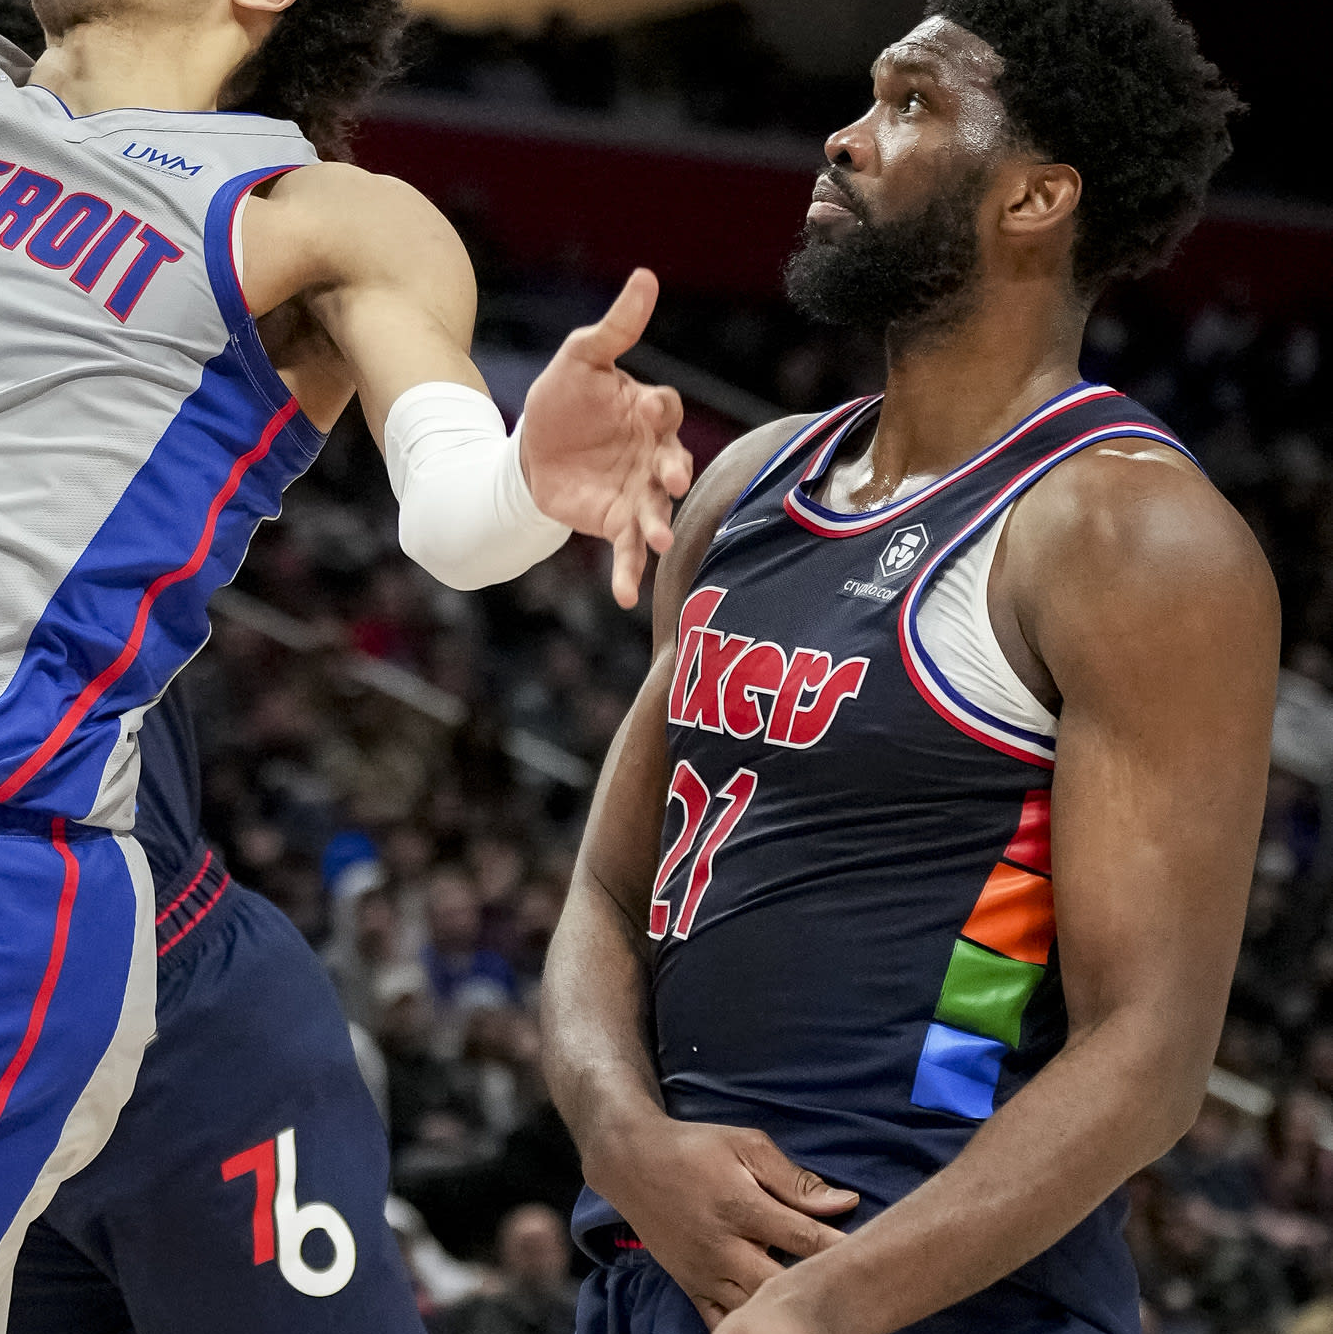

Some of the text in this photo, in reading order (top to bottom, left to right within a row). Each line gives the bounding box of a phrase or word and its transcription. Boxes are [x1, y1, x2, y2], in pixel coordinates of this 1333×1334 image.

[122, 142, 203, 176] UWM
[647, 760, 758, 941] 21
[221, 1126, 357, 1298] 76
